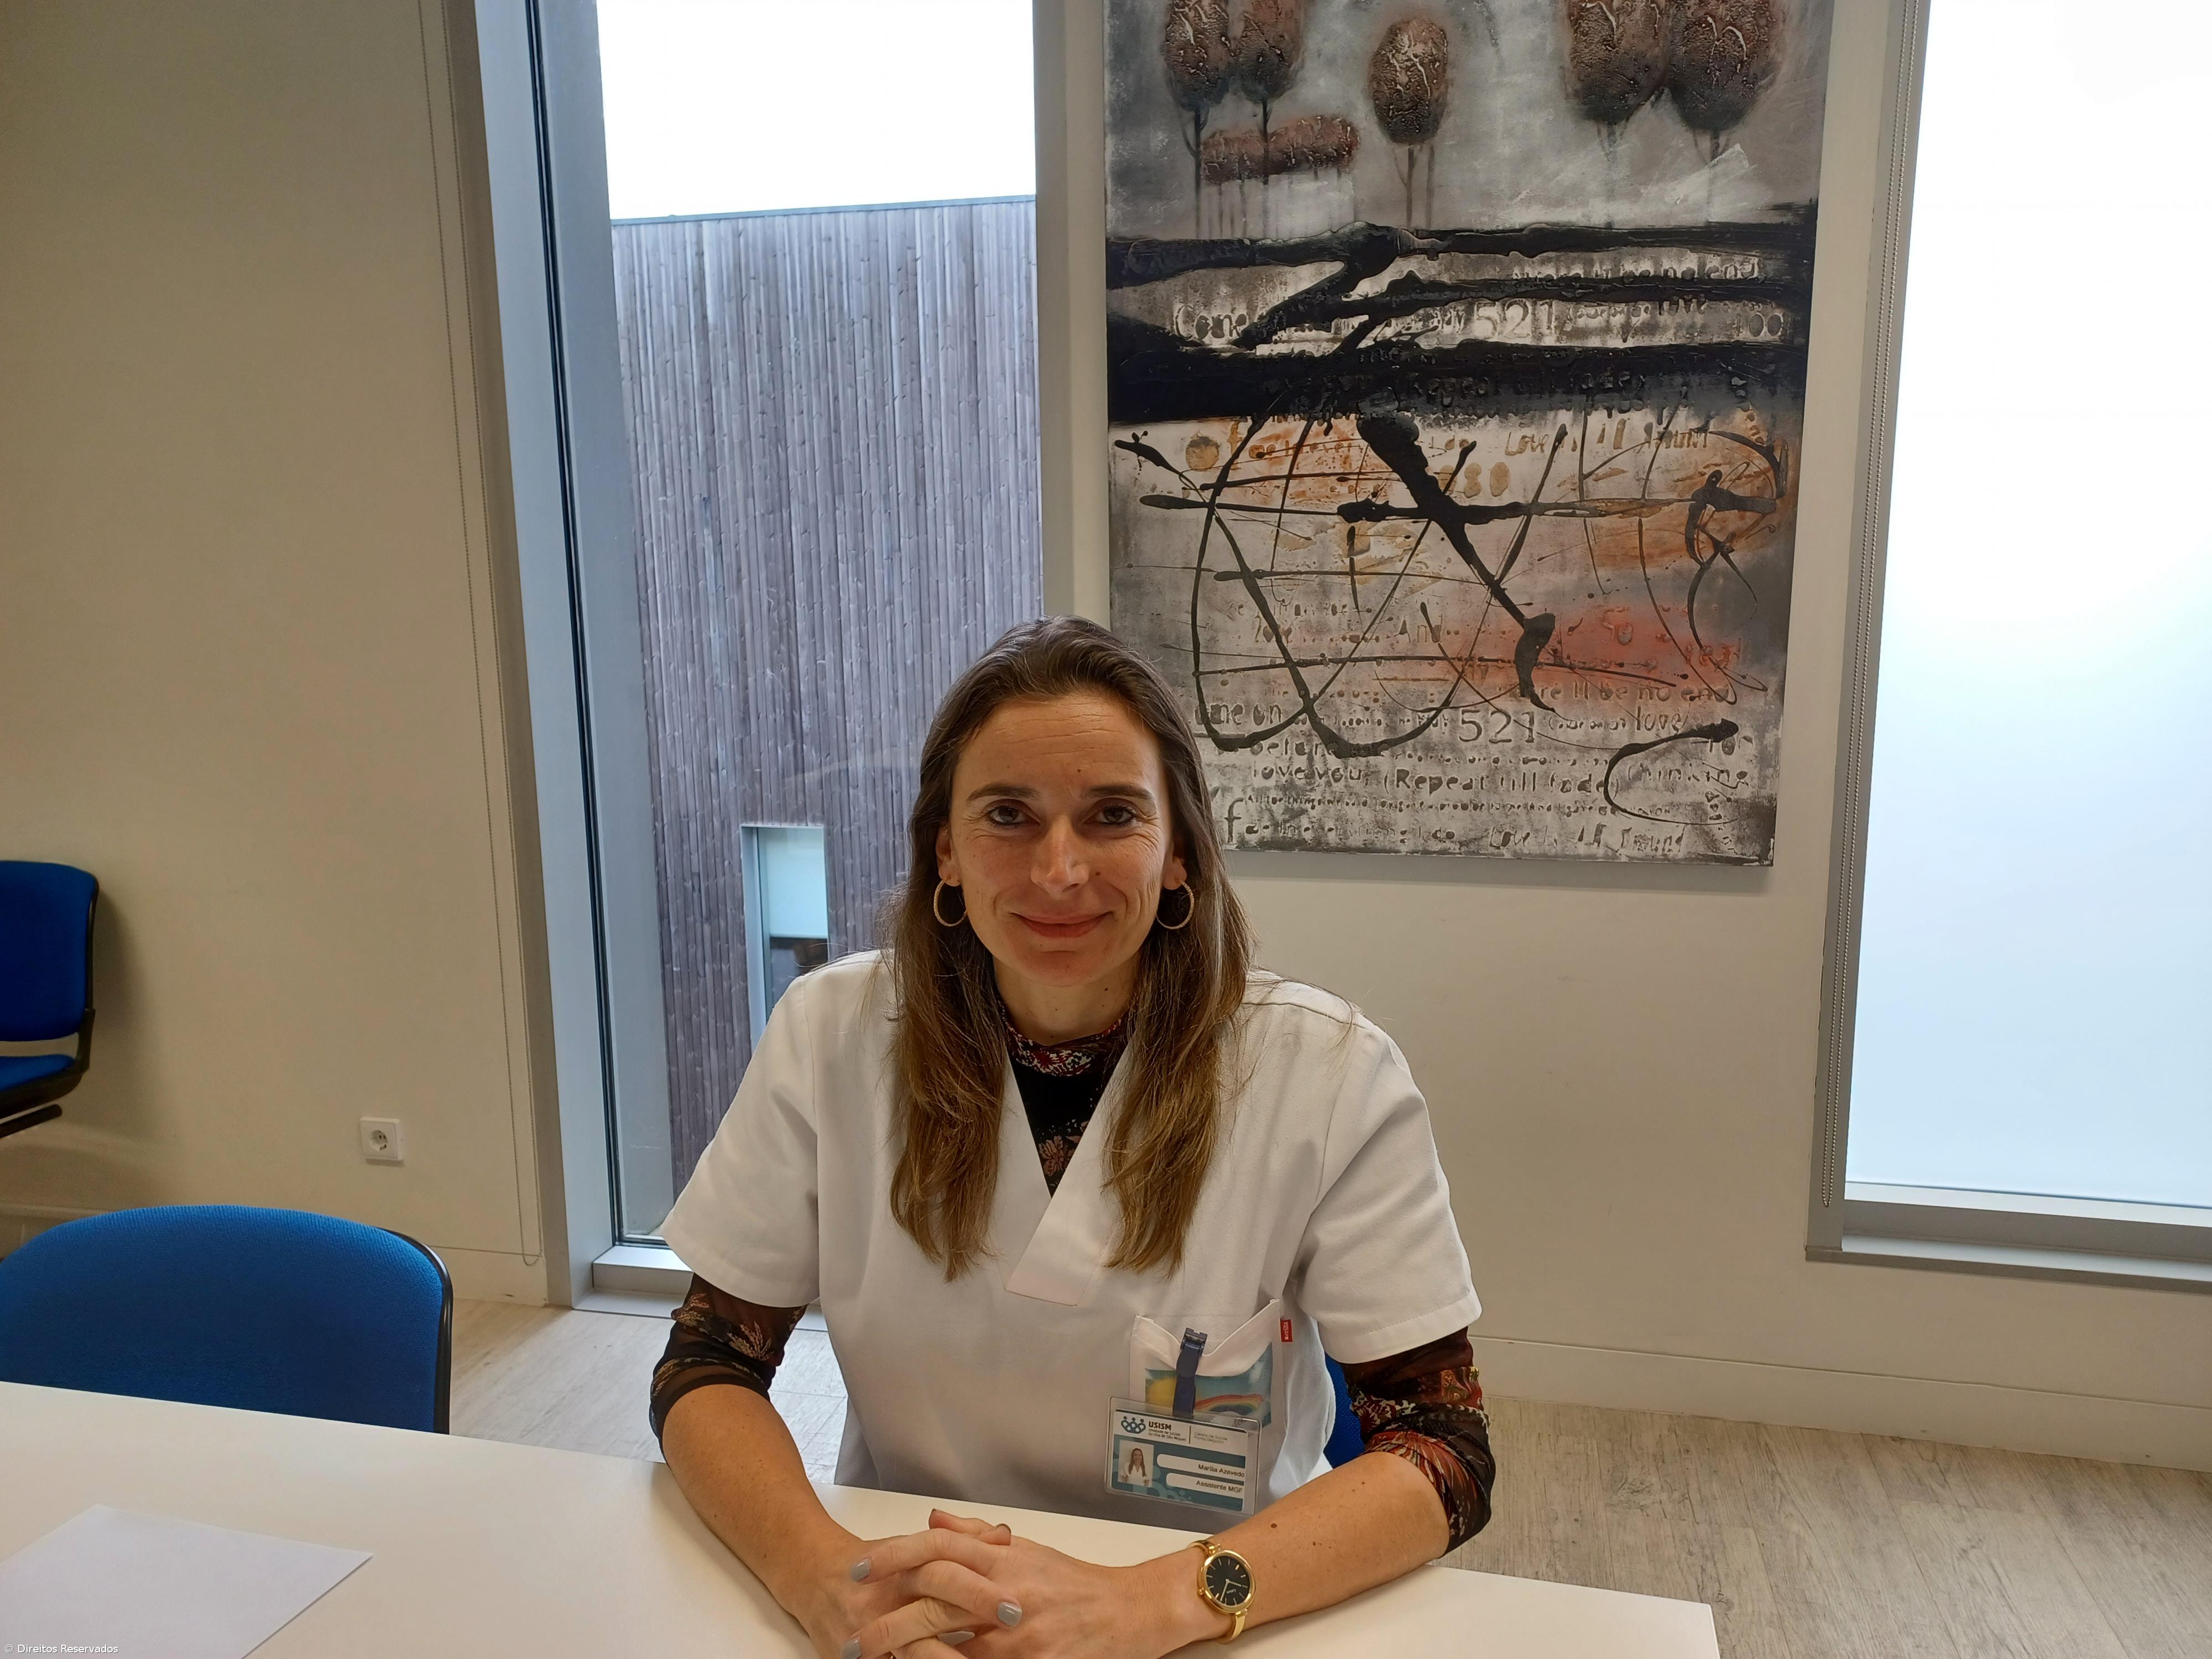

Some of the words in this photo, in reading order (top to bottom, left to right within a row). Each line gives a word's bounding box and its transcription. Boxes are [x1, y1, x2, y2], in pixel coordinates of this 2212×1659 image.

[1459, 709, 1535, 744] 521
[1149, 1421, 1172, 1431] USISM
[1219, 1468, 1245, 1477] Azevedo
[1196, 1480, 1227, 1491] Assistente
